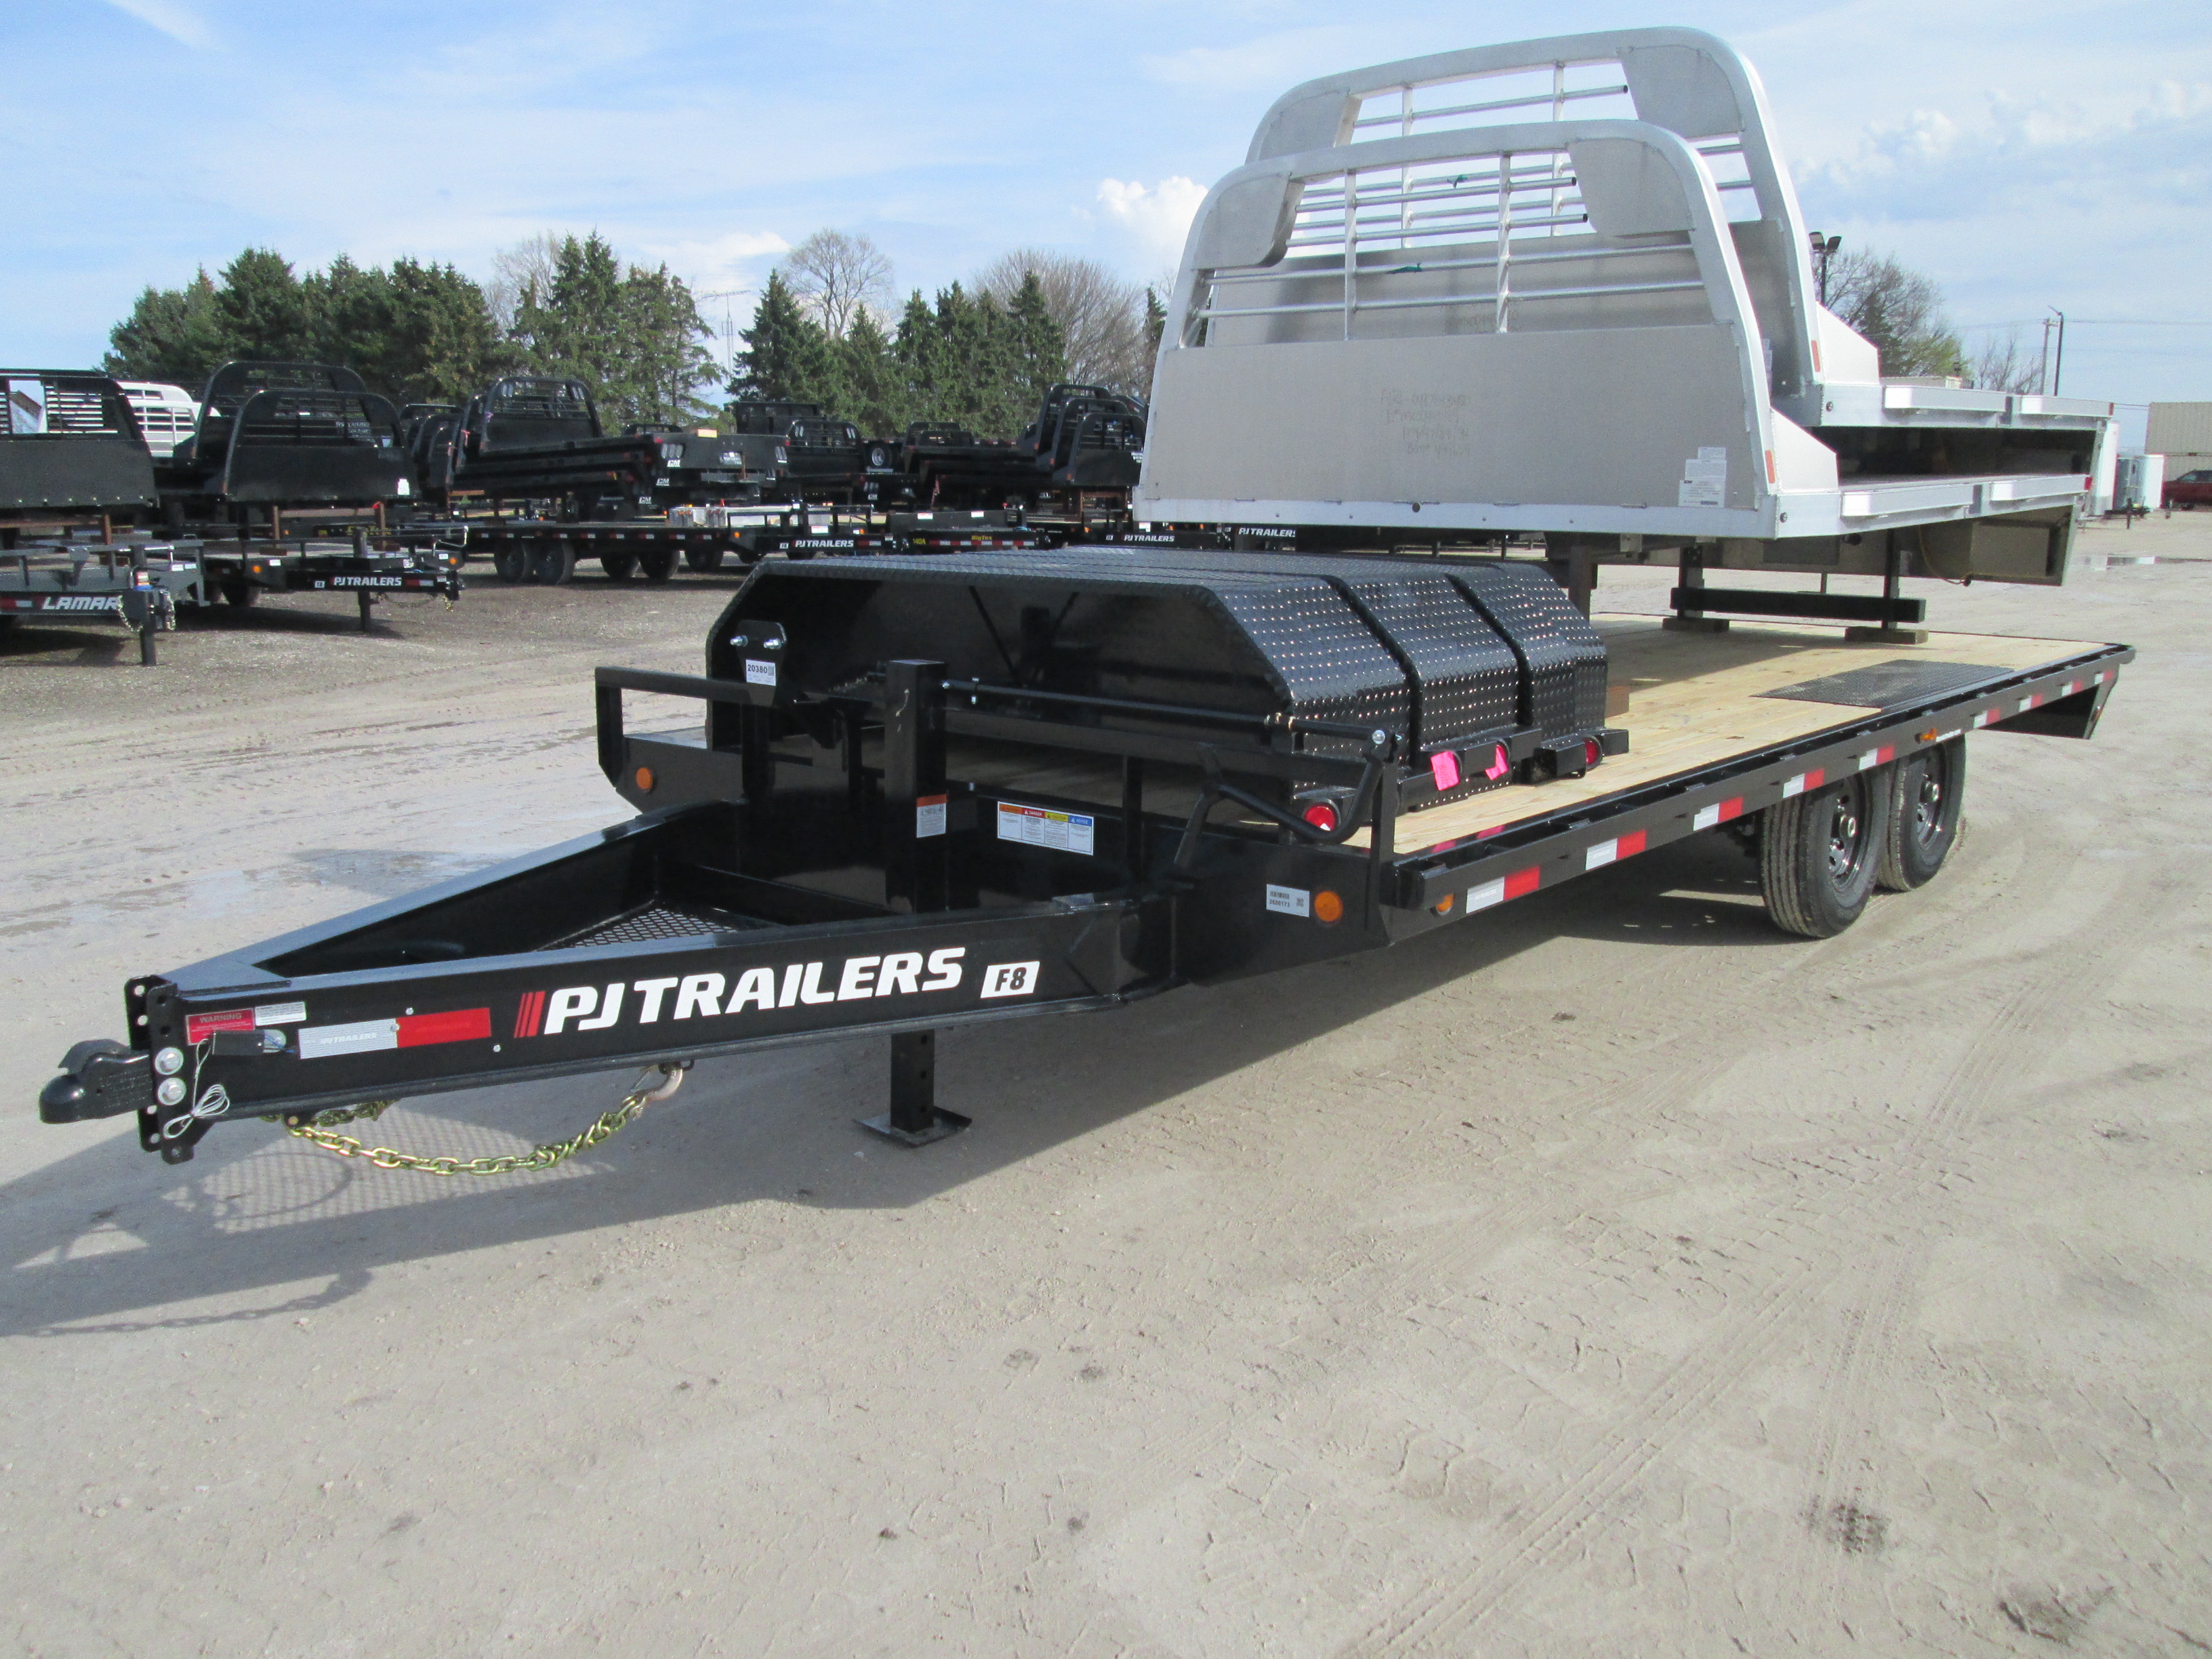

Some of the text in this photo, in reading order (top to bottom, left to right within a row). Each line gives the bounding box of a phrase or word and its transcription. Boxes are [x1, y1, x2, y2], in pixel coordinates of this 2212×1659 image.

[333, 577, 346, 586] PJ
[346, 577, 403, 586] TRAILERS
[42, 596, 119, 611] LAMAR
[747, 664, 767, 674] 20380
[543, 947, 1027, 1036] PJ TRAILERS F8
[199, 1012, 242, 1023] WARNING
